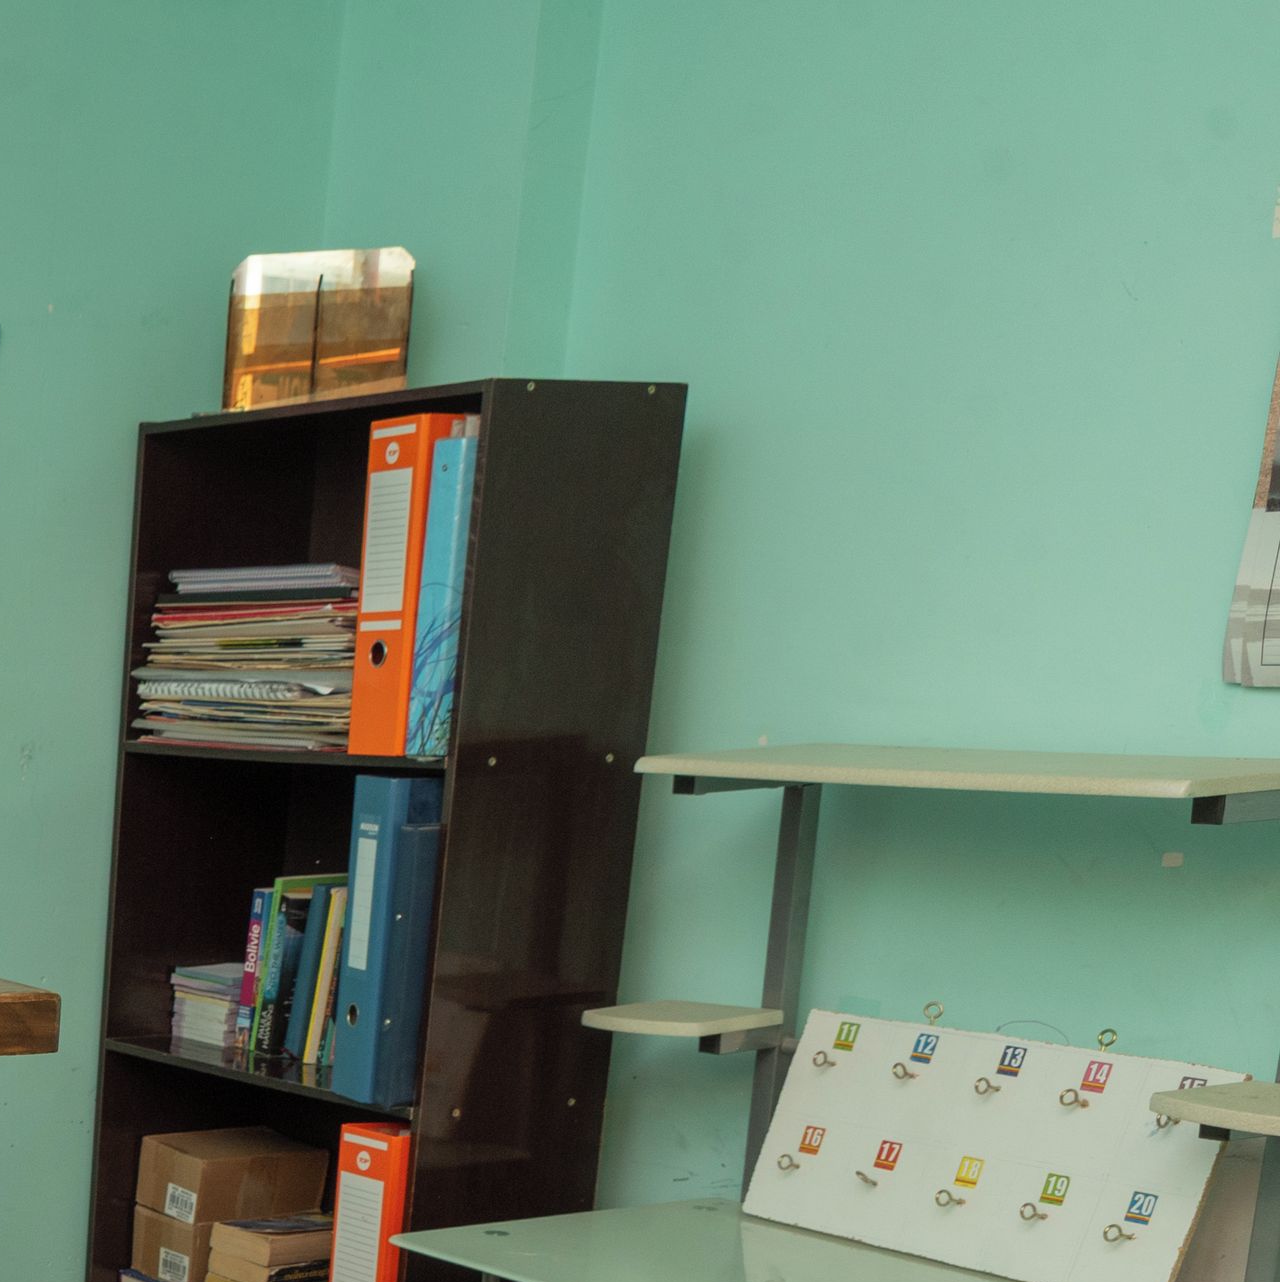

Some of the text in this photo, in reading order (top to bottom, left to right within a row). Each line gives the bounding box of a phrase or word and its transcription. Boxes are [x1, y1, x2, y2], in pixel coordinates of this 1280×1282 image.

[244, 923, 261, 973] Bolivie
[839, 1023, 858, 1042] 11
[915, 1036, 937, 1055] 12
[1003, 1048, 1024, 1068] 13
[1088, 1063, 1108, 1084] 14
[804, 1127, 824, 1147] 16
[880, 1142, 901, 1162] 17
[960, 1159, 981, 1179] 18
[1046, 1176, 1067, 1197] 19
[1130, 1194, 1155, 1217] 20
